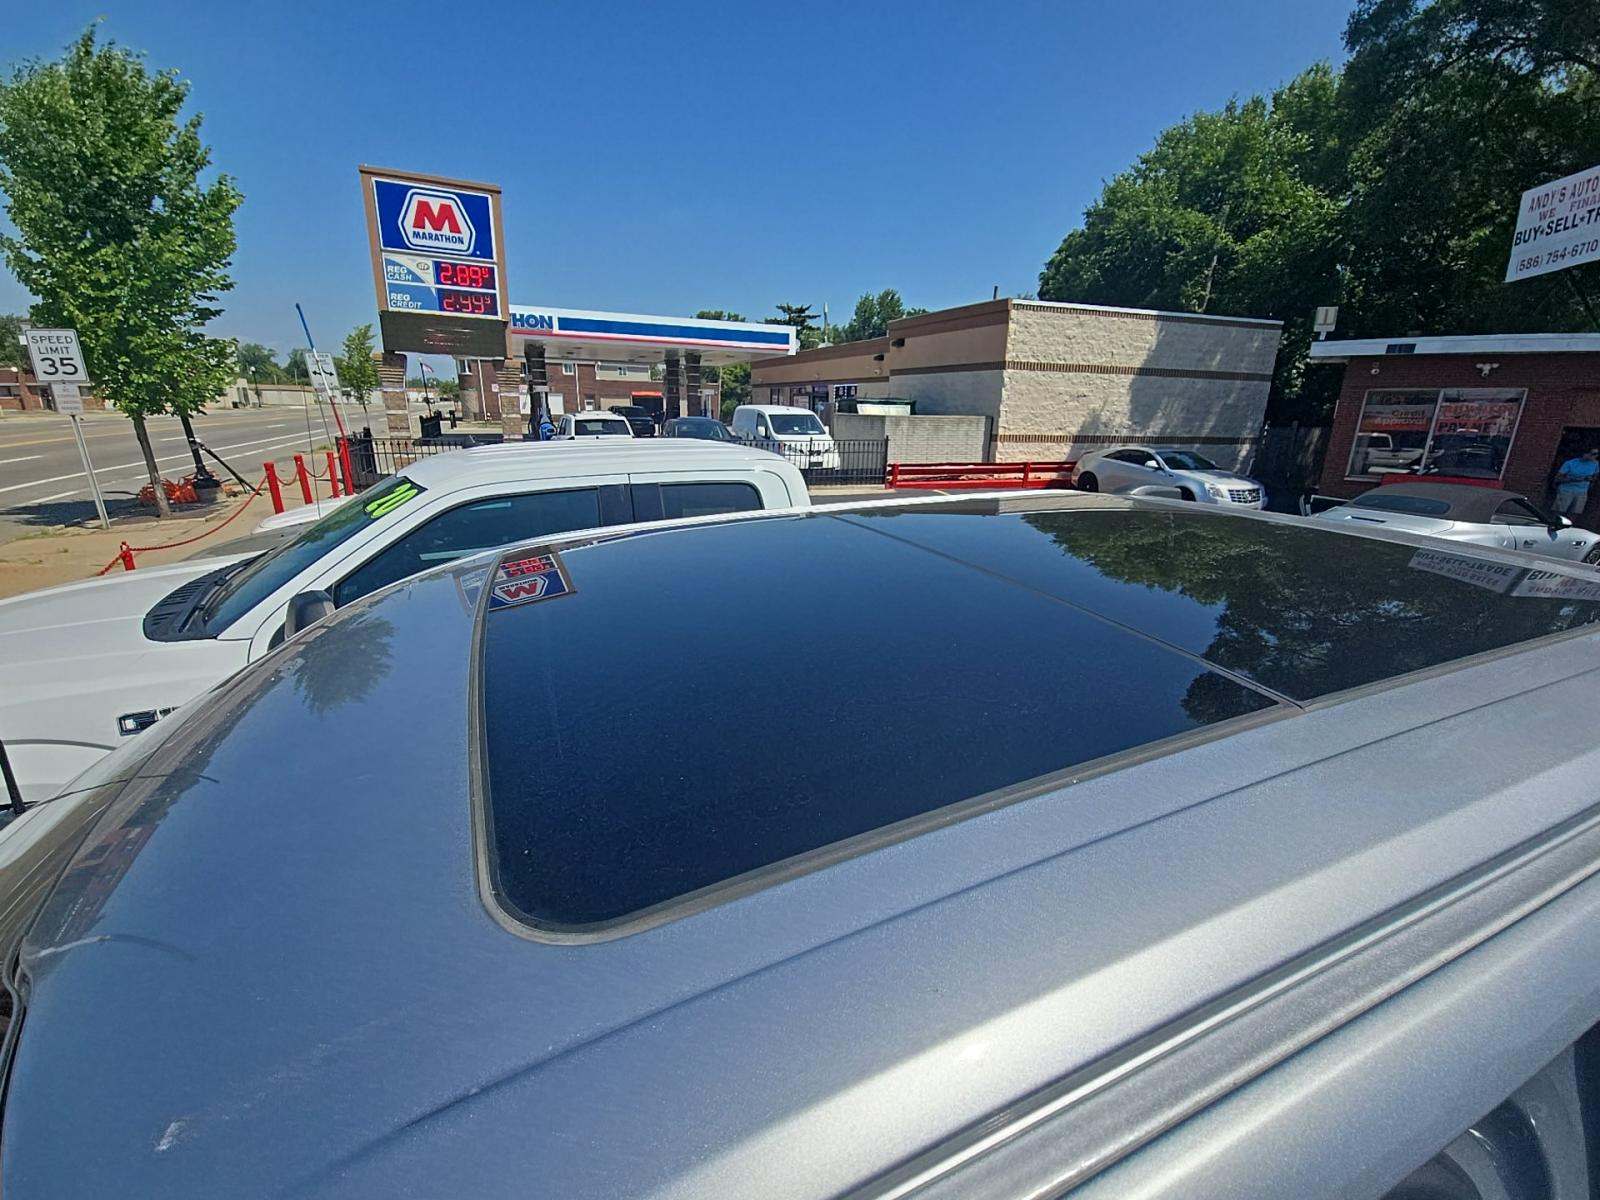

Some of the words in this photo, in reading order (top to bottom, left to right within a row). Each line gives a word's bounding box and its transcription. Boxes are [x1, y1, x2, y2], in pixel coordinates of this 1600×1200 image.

[1528, 187, 1566, 213] ANDY'S
[1569, 175, 1600, 200] AUTO
[412, 199, 462, 234] M
[1538, 208, 1557, 222] WE
[412, 230, 465, 245] MARATHON
[1515, 254, 1544, 273] (586)
[1545, 239, 1599, 265] 754-6710
[387, 265, 407, 274] REG
[387, 272, 412, 281] CASH
[390, 293, 411, 301] REG
[390, 300, 423, 309] CREDIT
[31, 335, 74, 345] SPEED
[37, 346, 71, 355] LIMIT
[40, 357, 79, 376] 35
